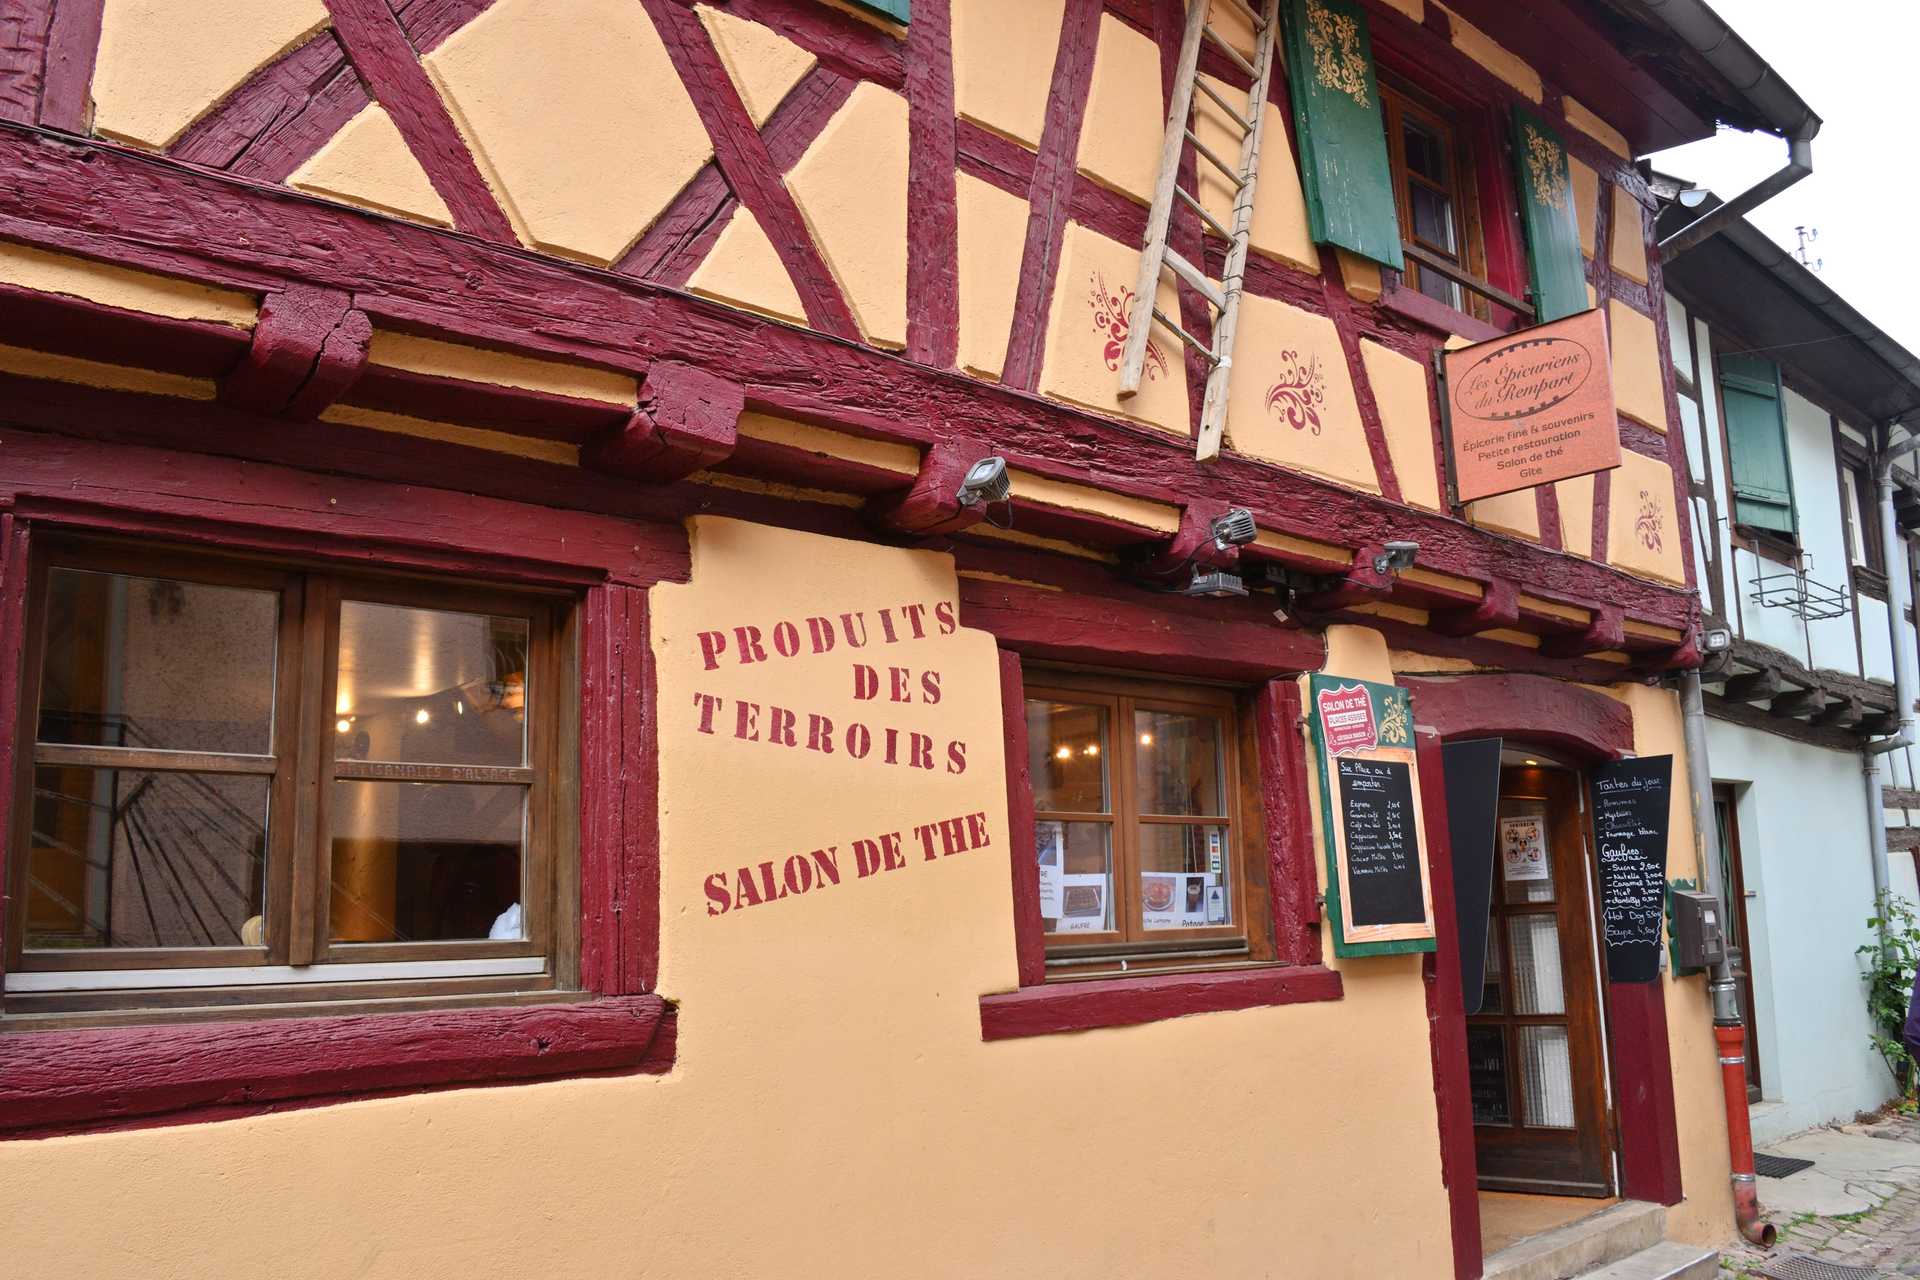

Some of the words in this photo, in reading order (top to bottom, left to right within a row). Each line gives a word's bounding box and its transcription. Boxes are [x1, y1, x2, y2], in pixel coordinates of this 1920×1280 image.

[1464, 375, 1493, 395] Les
[1494, 352, 1581, 386] Épicuriens
[1475, 394, 1496, 409] du
[1497, 371, 1574, 405] Rempart
[1463, 434, 1505, 452] Épicerie
[1507, 429, 1529, 441] fine
[1530, 425, 1540, 434] &
[1542, 412, 1595, 431] souvenirs
[1478, 446, 1511, 462] Petite
[1512, 429, 1582, 453] restauration
[1496, 456, 1528, 470] Salon
[1529, 452, 1543, 463] de
[1545, 446, 1564, 459] thé
[697, 601, 958, 671] PRODUITS
[852, 664, 942, 705] DES
[1322, 700, 1345, 713] SALON
[1345, 698, 1356, 709] DE
[694, 693, 967, 775] TERROIRS
[1596, 778, 1628, 791] Tartes
[1631, 776, 1642, 787] du
[703, 846, 840, 917] SALON
[852, 832, 906, 879] DE
[914, 812, 991, 862] THE
[1613, 872, 1640, 880] Nutella
[1613, 879, 1643, 888] Caramel
[1613, 888, 1631, 896] Miel
[1608, 911, 1624, 920] Hot
[1629, 911, 1645, 924] Dog
